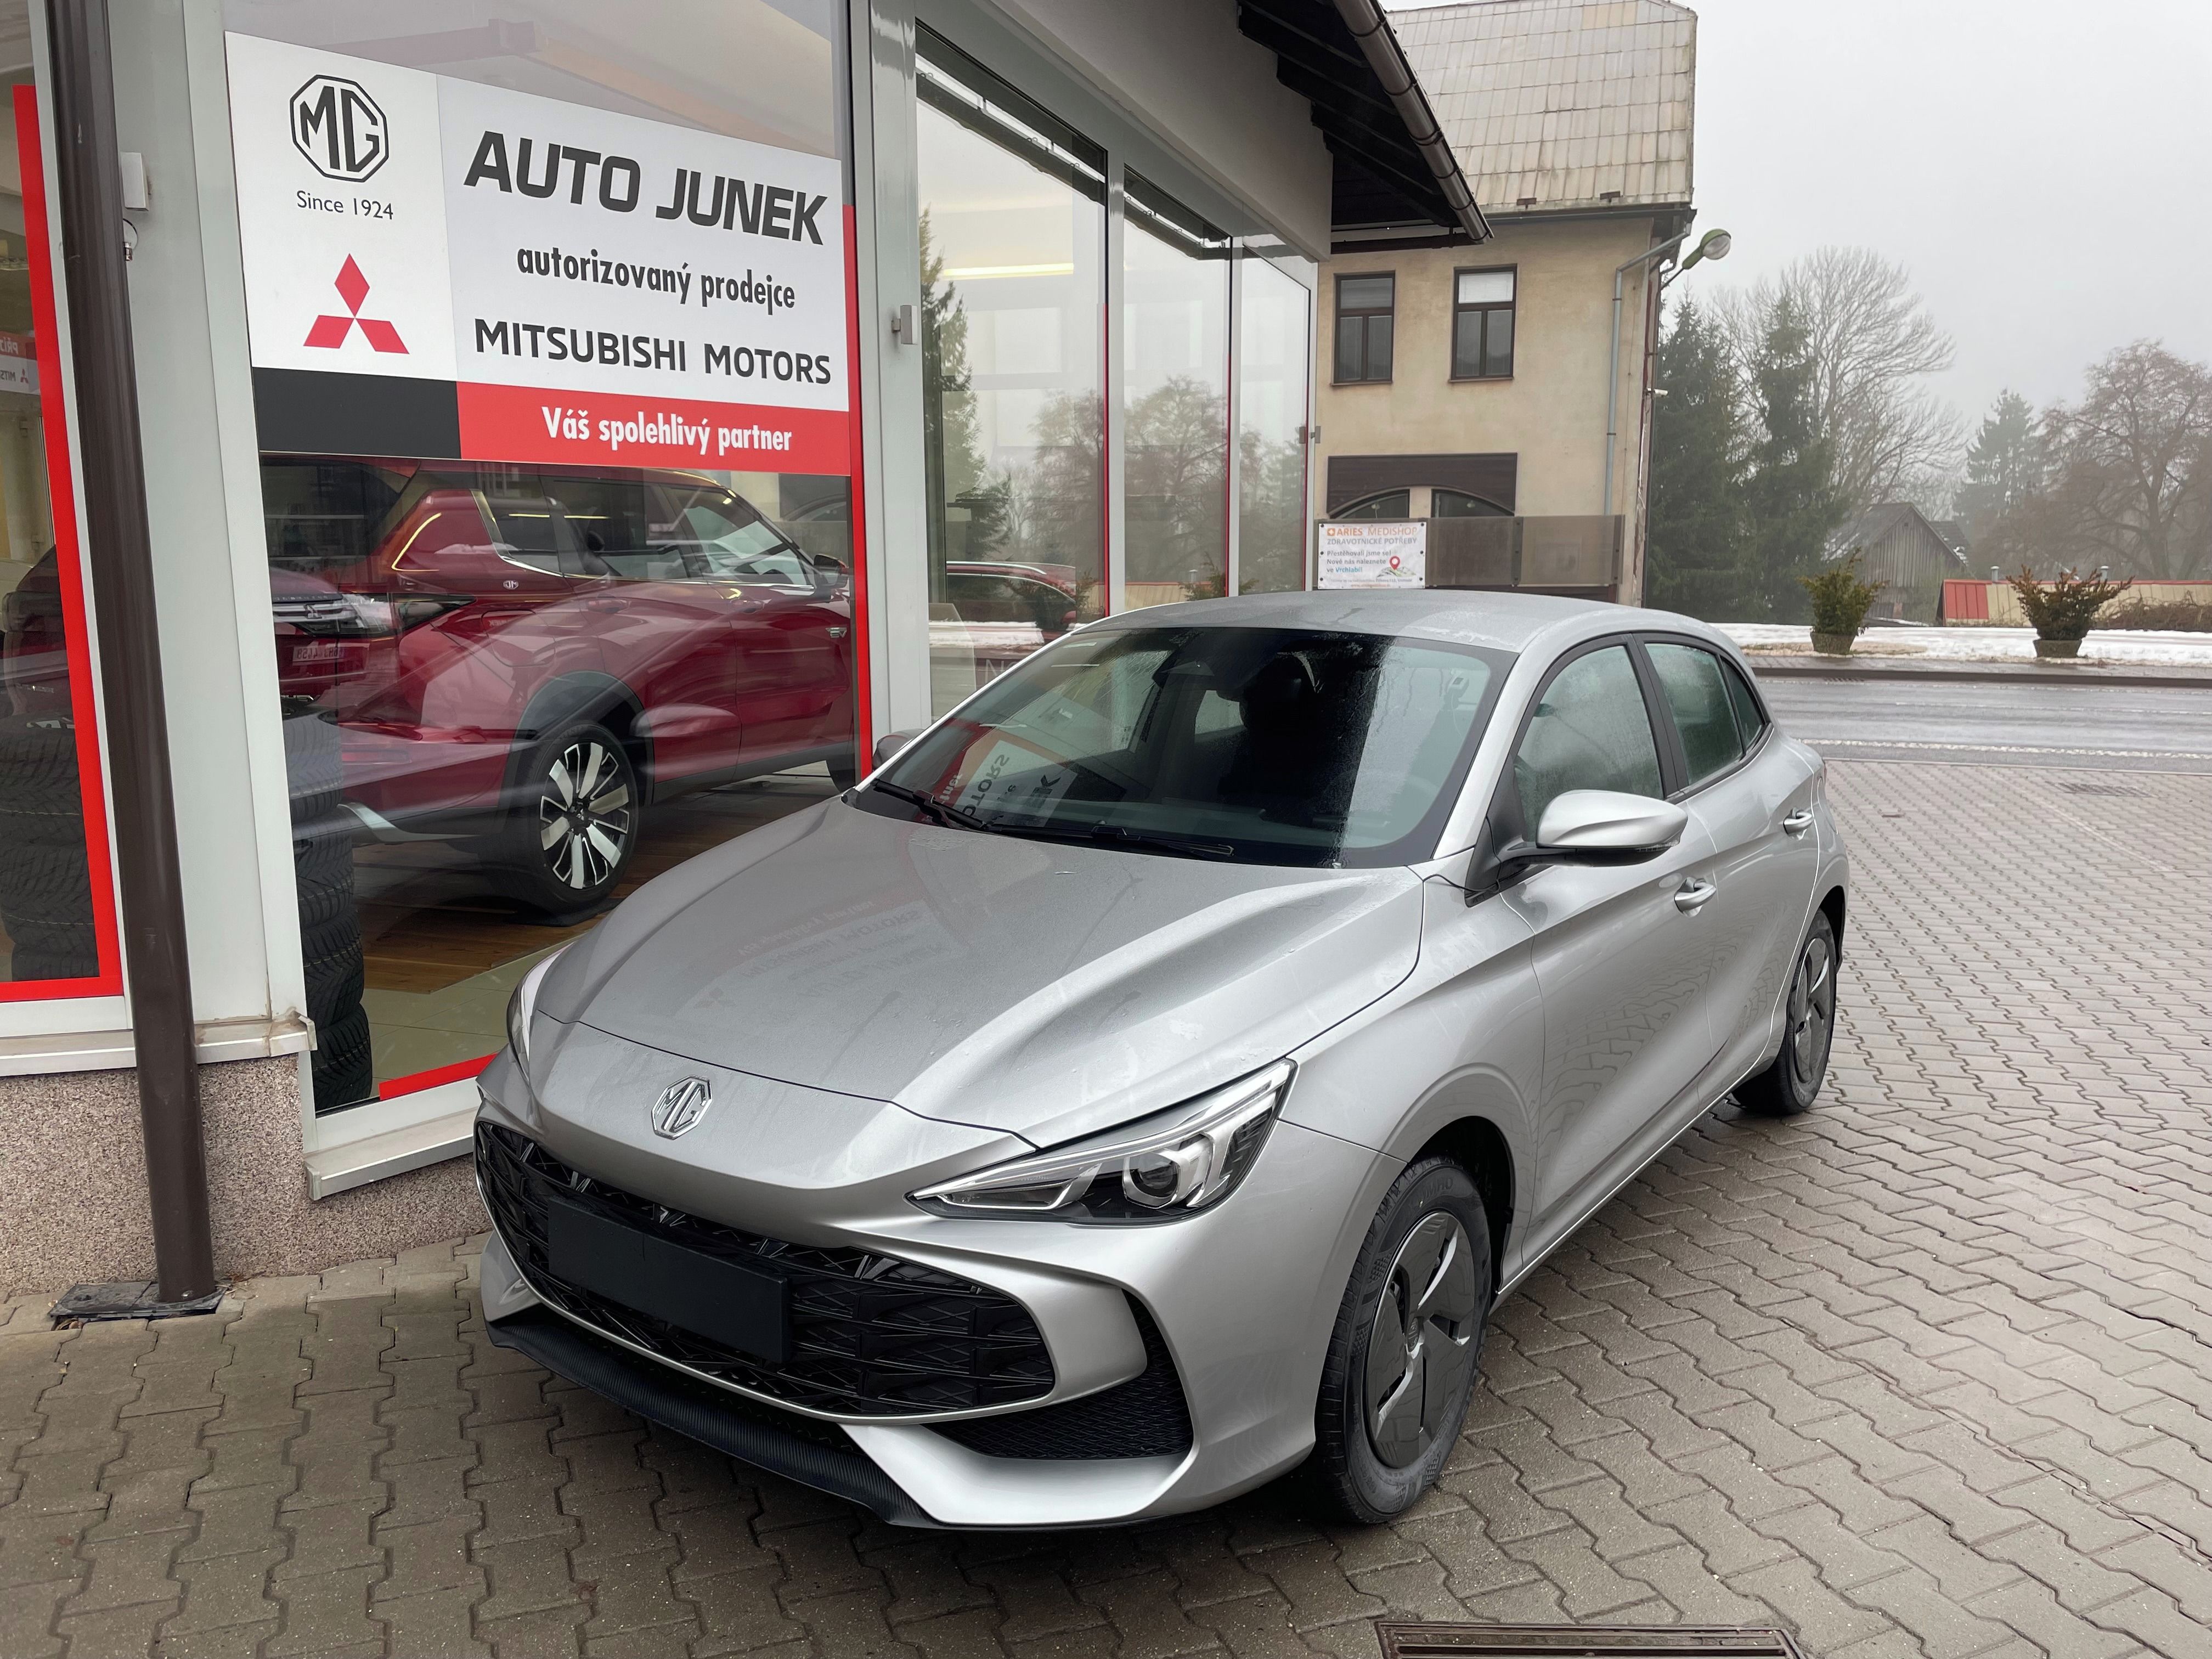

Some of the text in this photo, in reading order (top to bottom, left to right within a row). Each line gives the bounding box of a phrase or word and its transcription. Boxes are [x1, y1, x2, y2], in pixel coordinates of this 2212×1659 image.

[299, 84, 380, 173] MG
[296, 189, 394, 221] Since 1924
[462, 130, 828, 246] AUTO JUNEK
[517, 246, 795, 316] autorizovaný prodejce
[474, 318, 831, 385] MITSUBISHI MOTORS
[541, 406, 792, 456] Váš spolehlivý partner
[1327, 537, 1417, 545] ZDRAVOTNICKÉ POTŘEBY
[1336, 527, 1418, 536] ARIES MEDISHOP
[657, 1081, 707, 1133] MG
